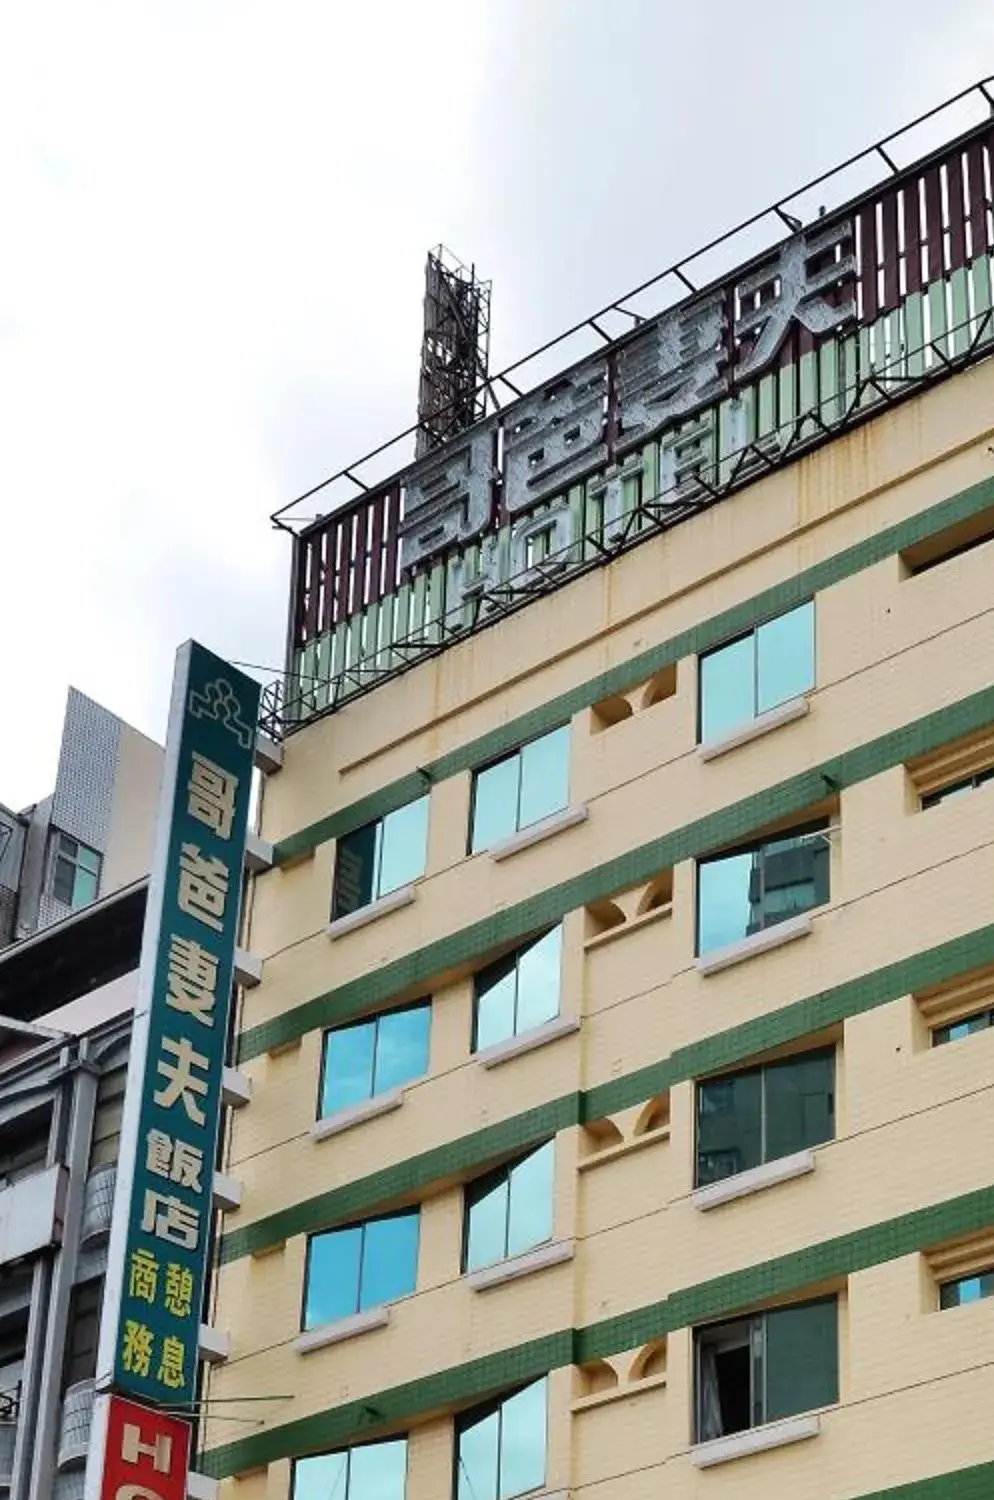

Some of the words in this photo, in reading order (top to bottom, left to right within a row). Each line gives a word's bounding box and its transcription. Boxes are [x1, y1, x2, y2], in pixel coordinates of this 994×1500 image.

[446, 396, 787, 630] HOTEL
[140, 751, 240, 1251] 哥爸妻夫飯店
[122, 1248, 159, 1377] 商務
